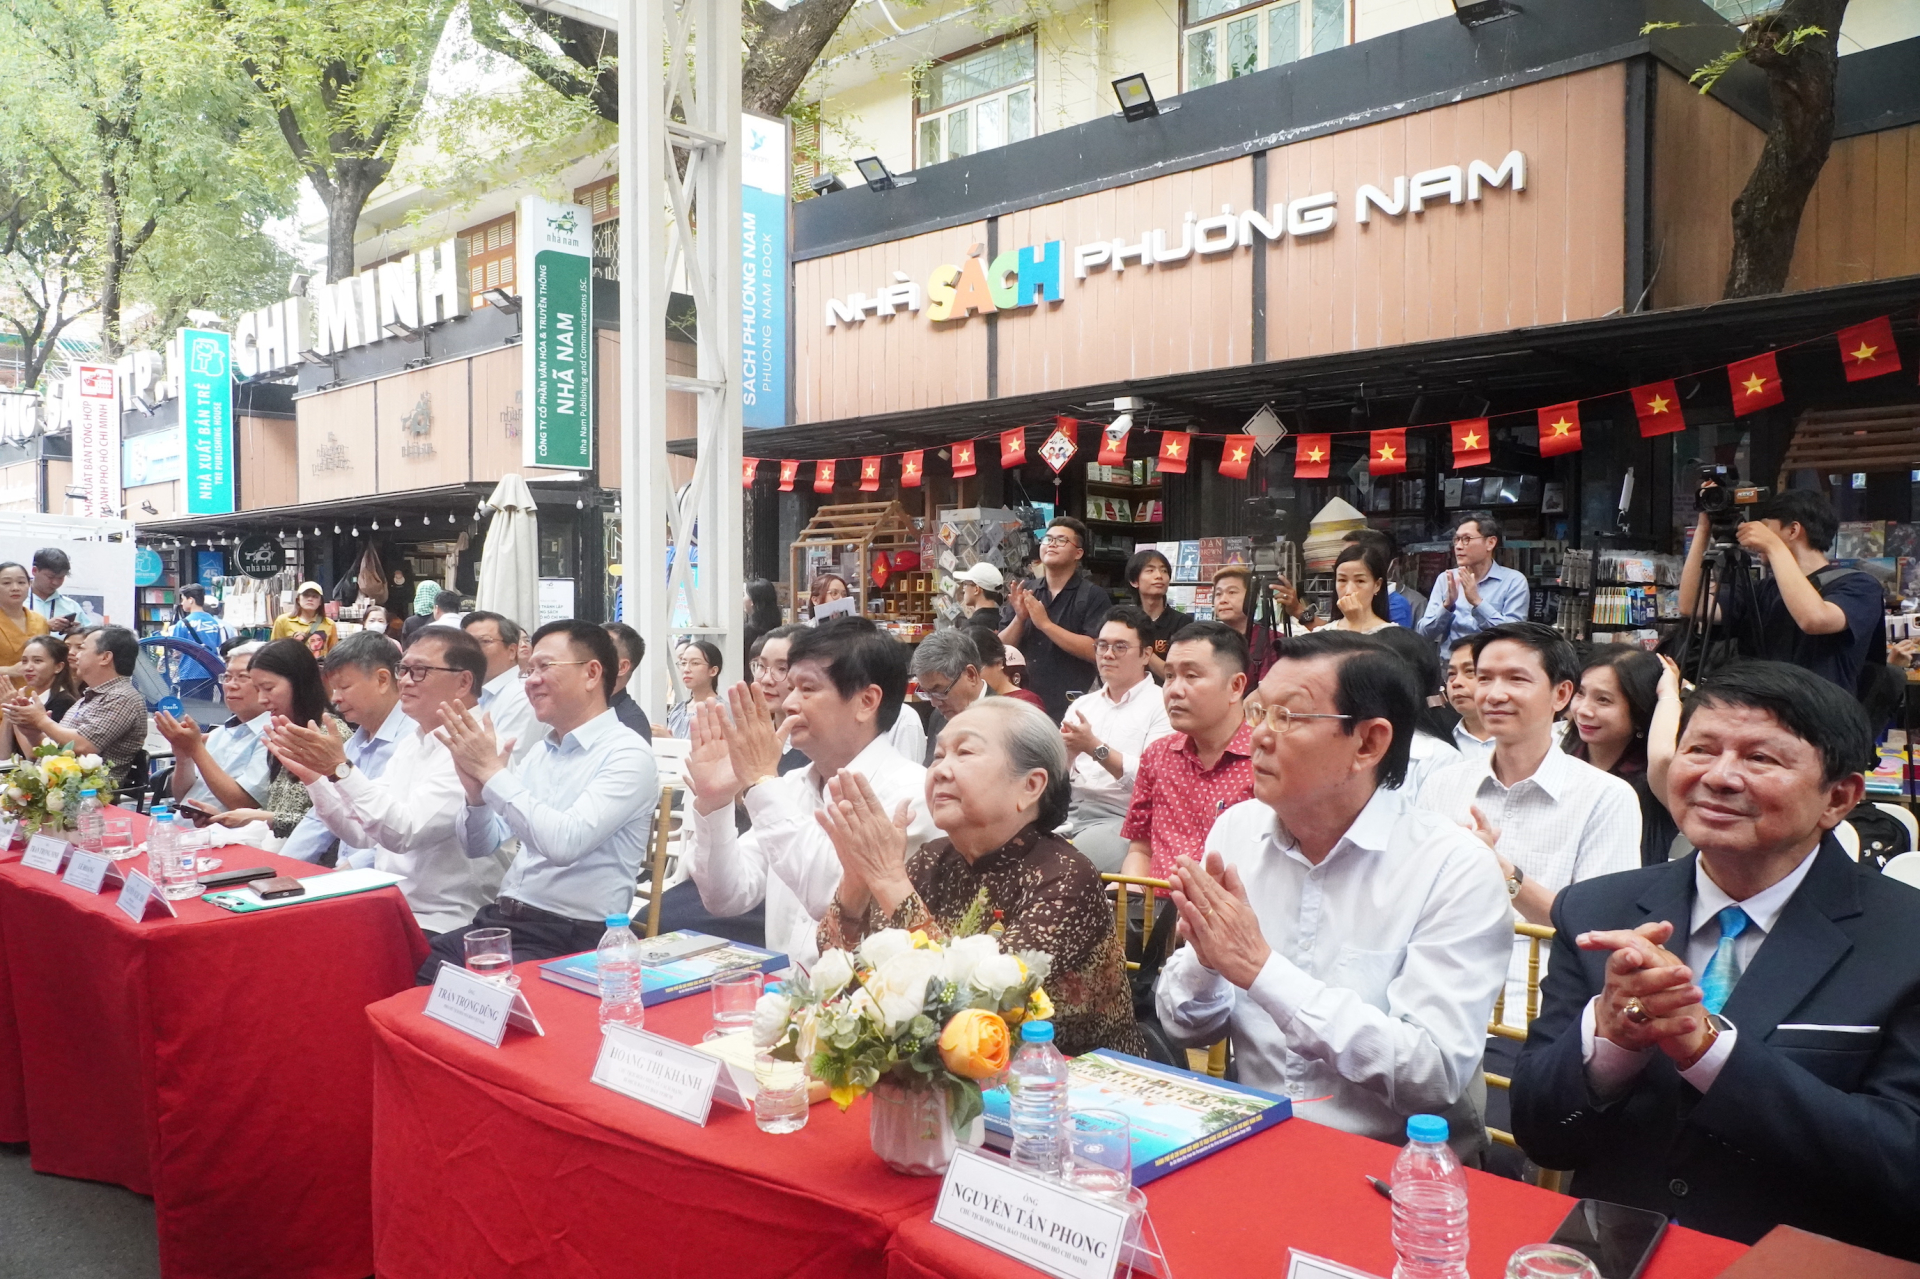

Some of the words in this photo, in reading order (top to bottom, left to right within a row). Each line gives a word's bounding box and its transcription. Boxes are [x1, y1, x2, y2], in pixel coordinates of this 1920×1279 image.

[743, 211, 756, 259] NAM
[825, 270, 920, 327] NHÀ
[925, 240, 1065, 322] SÁCH
[1074, 191, 1338, 279] PHƯƠNG
[1355, 149, 1528, 224] NAM
[762, 233, 772, 278] BOOK
[537, 264, 548, 294] THÔNG
[318, 238, 468, 356] MINH
[762, 283, 772, 320] NAM
[537, 297, 548, 330] TRUYỀN
[580, 294, 588, 359] Communications
[538, 341, 548, 359] HÓA
[557, 312, 574, 362] NAM
[538, 360, 548, 379] VĂN
[580, 360, 588, 376] and
[762, 324, 772, 392] PHUONG
[193, 382, 210, 406] TRẺ
[537, 380, 548, 404] PHẦN
[552, 368, 575, 415] NHÃ
[580, 377, 589, 417] Publishing
[98, 404, 108, 429] MINH
[194, 410, 211, 435] BẢN
[213, 402, 222, 426] HOUSE
[539, 420, 548, 430] TY
[580, 419, 588, 437] Nam
[194, 438, 212, 470] XUẤT
[214, 426, 223, 470] PUBLISHING
[538, 432, 548, 456] CÔNG
[580, 438, 588, 455] Nha
[196, 474, 212, 500] NHÀ
[214, 472, 224, 485] TRE
[1200, 539, 1222, 548] DAN
[664, 1066, 703, 1091] KHÁNH
[1022, 1193, 1039, 1206] ÔNG
[951, 1182, 1013, 1219] NGUYỄN
[1015, 1208, 1048, 1234] TẤN
[1050, 1222, 1108, 1260] PHONG
[1006, 1224, 1019, 1236] BÁO
[1019, 1228, 1038, 1245] THÀNH
[1060, 1246, 1072, 1258] CHÍ
[1070, 1251, 1088, 1266] MINH
